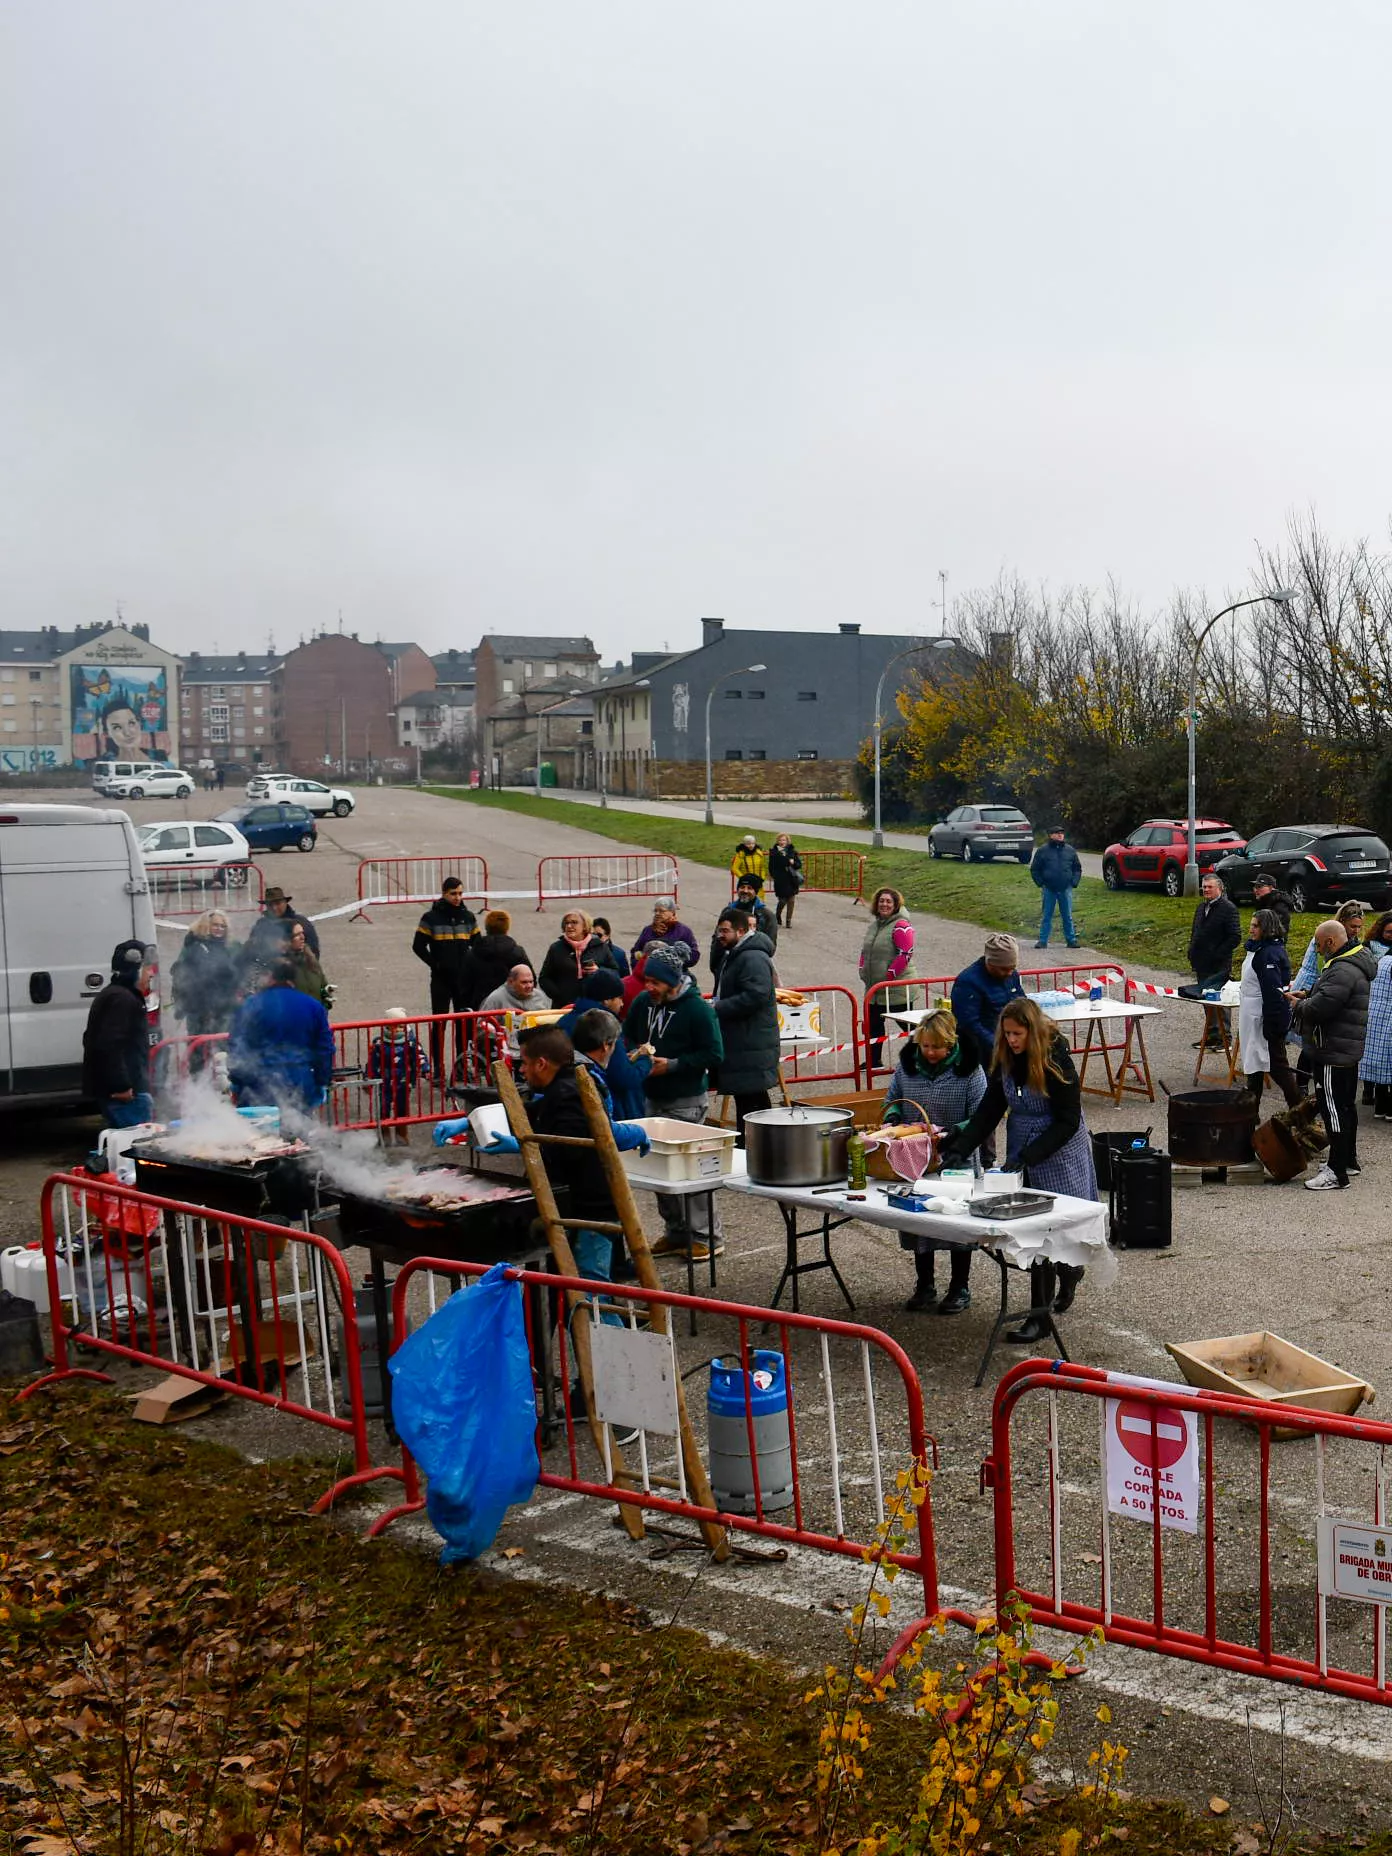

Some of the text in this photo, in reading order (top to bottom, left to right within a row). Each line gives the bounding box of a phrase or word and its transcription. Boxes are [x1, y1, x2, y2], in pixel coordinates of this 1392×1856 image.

[1120, 1496, 1128, 1505] A
[1132, 1498, 1146, 1510] 50
[1340, 1554, 1375, 1569] BRIGADA
[1357, 1568, 1370, 1579] DE
